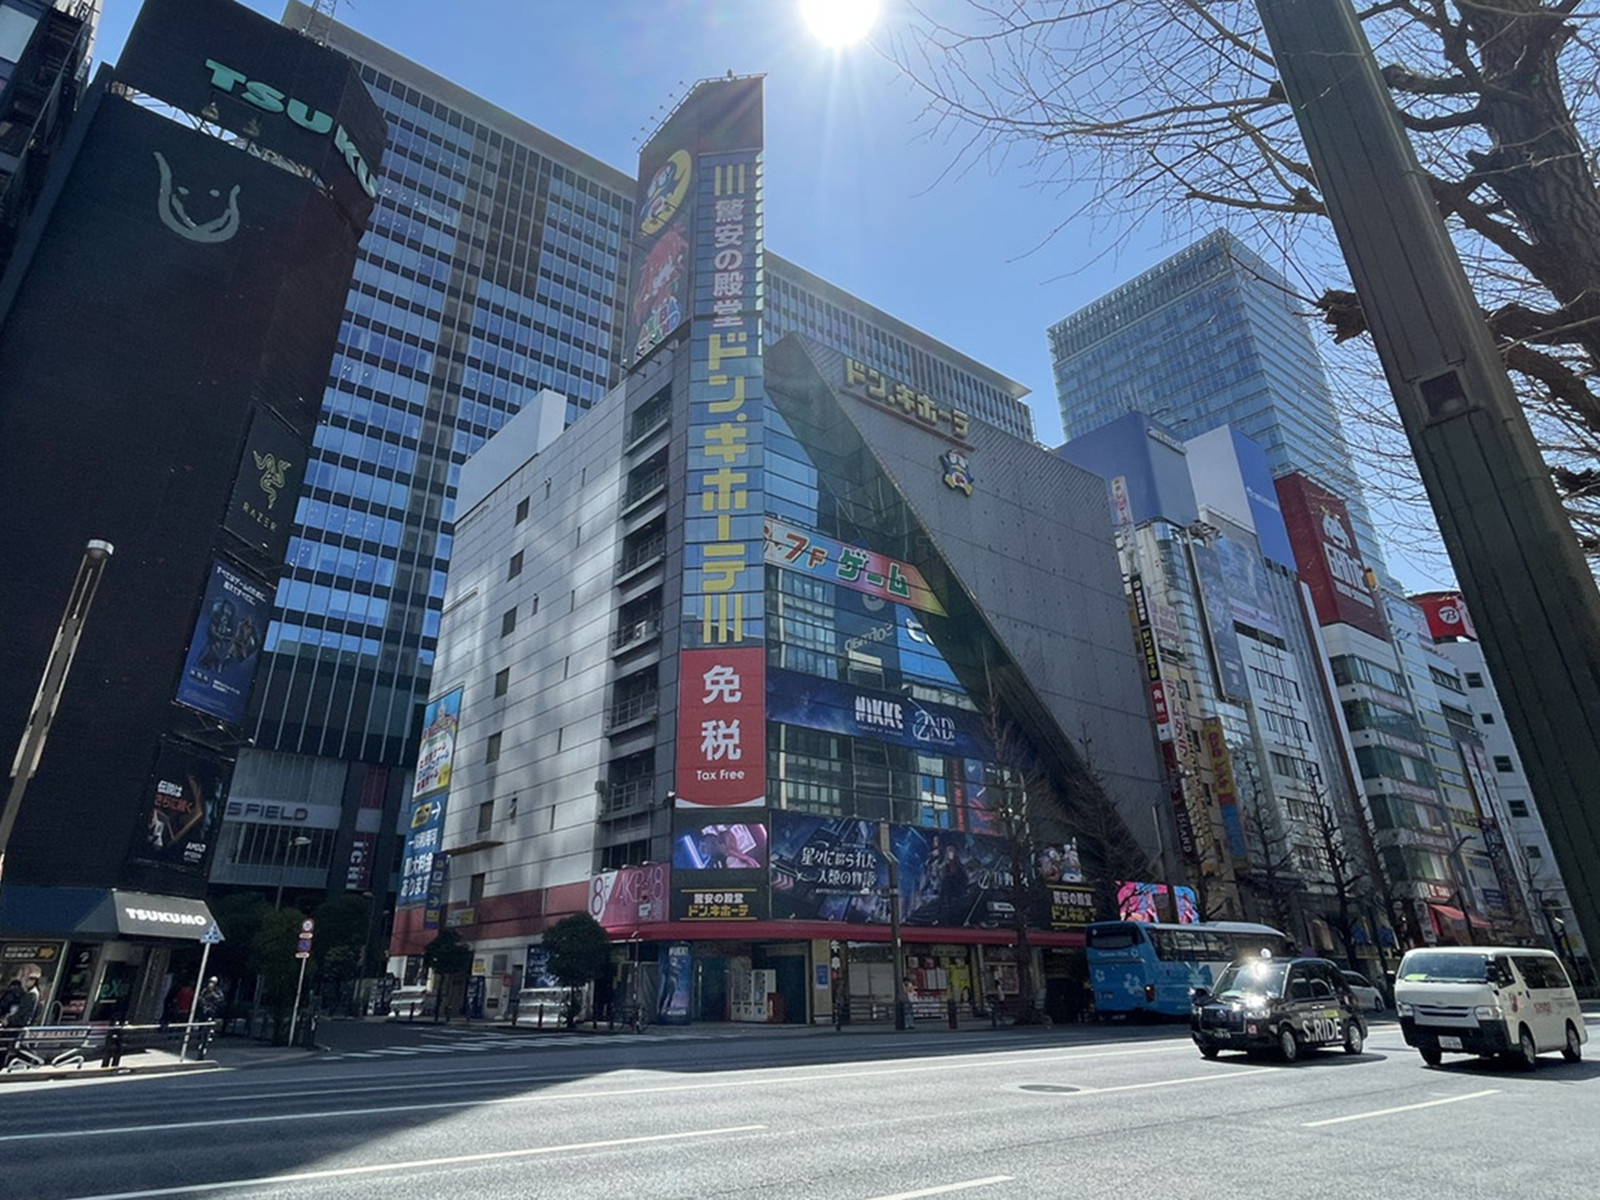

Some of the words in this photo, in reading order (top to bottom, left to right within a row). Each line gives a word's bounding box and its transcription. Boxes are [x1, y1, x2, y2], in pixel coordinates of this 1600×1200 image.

[712, 198, 746, 328] 驚安の殿堂
[242, 502, 278, 532] RAZER
[836, 546, 911, 600] ゲーム
[700, 664, 743, 761] 免税
[855, 695, 904, 730] NIKKE
[696, 770, 717, 782] Tax
[719, 769, 745, 781] Free
[401, 874, 430, 897] あります
[124, 907, 208, 927] TSUKUMO
[1301, 1018, 1344, 1043] S.RIDE
